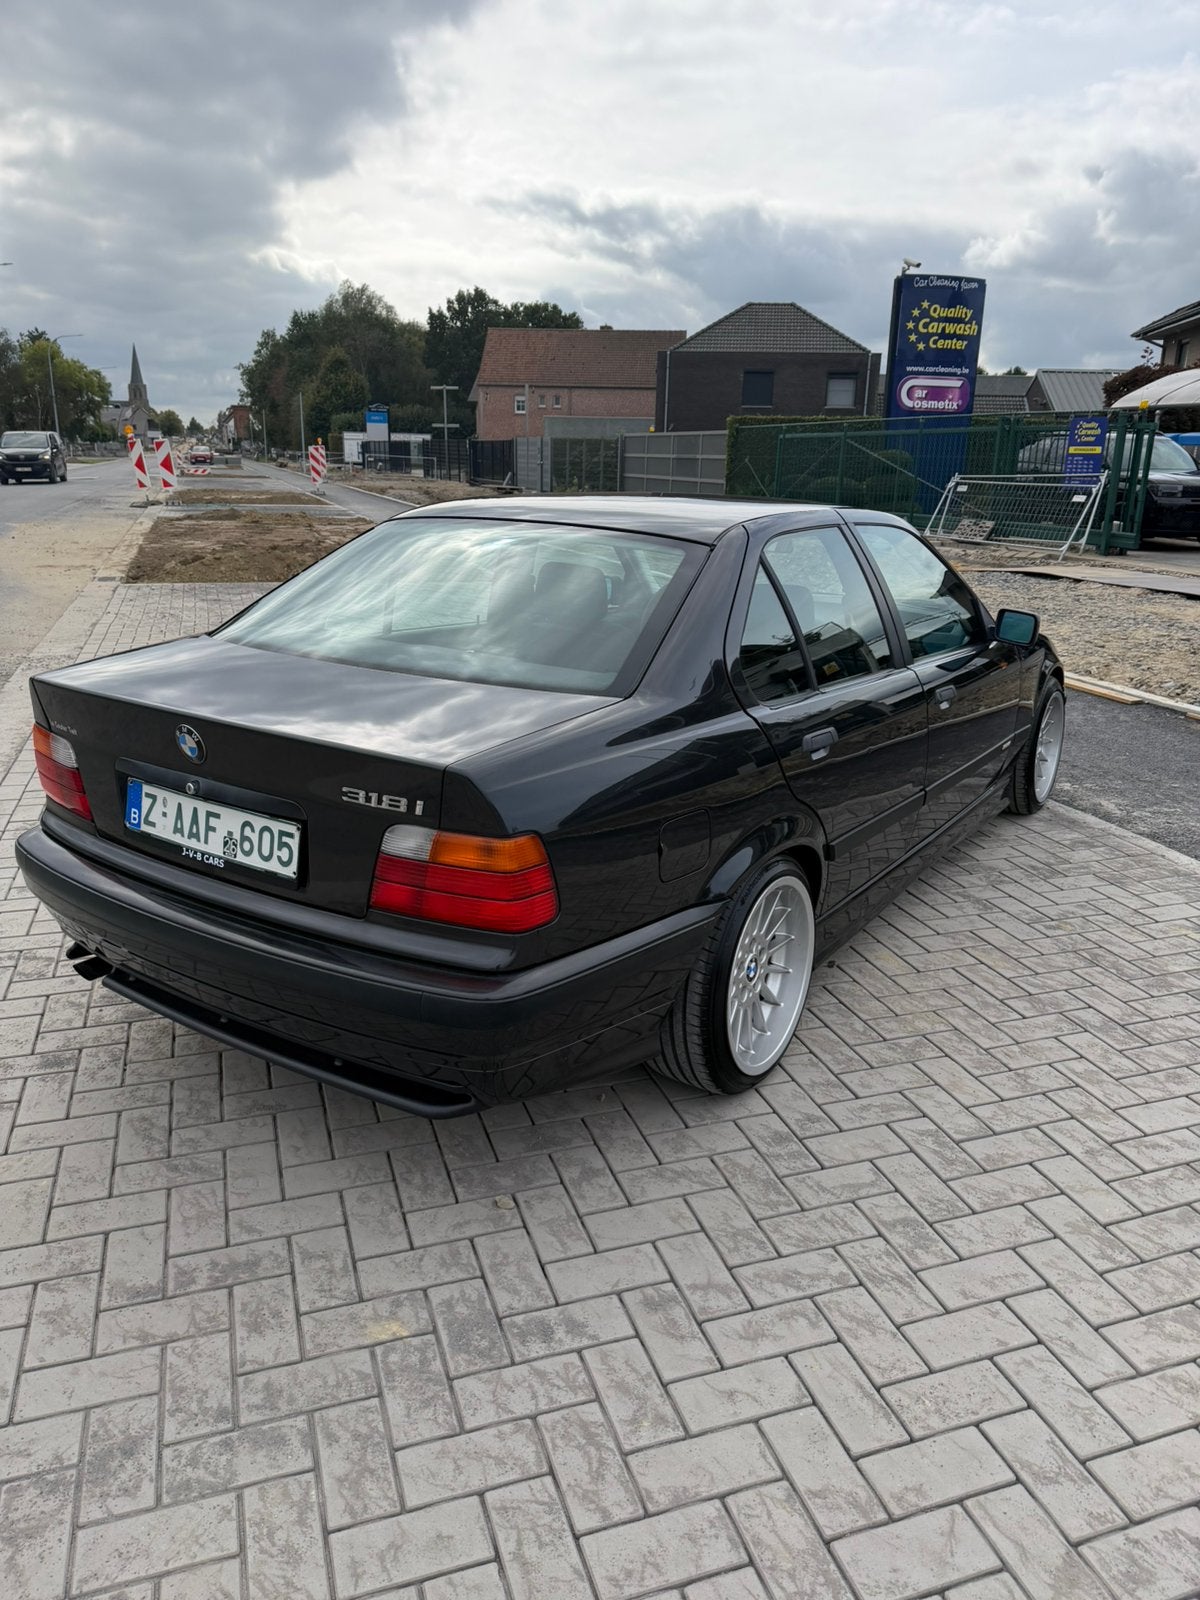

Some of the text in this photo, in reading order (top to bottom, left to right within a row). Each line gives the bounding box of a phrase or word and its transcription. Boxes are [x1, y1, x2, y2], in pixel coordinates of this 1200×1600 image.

[913, 276, 928, 288] Car
[929, 304, 974, 321] Quality
[918, 318, 978, 336] Carwash
[929, 336, 968, 350] Center
[906, 365, 970, 375] www.carcleaning.be
[130, 808, 139, 824] B
[181, 847, 225, 868] J-V-B CARS
